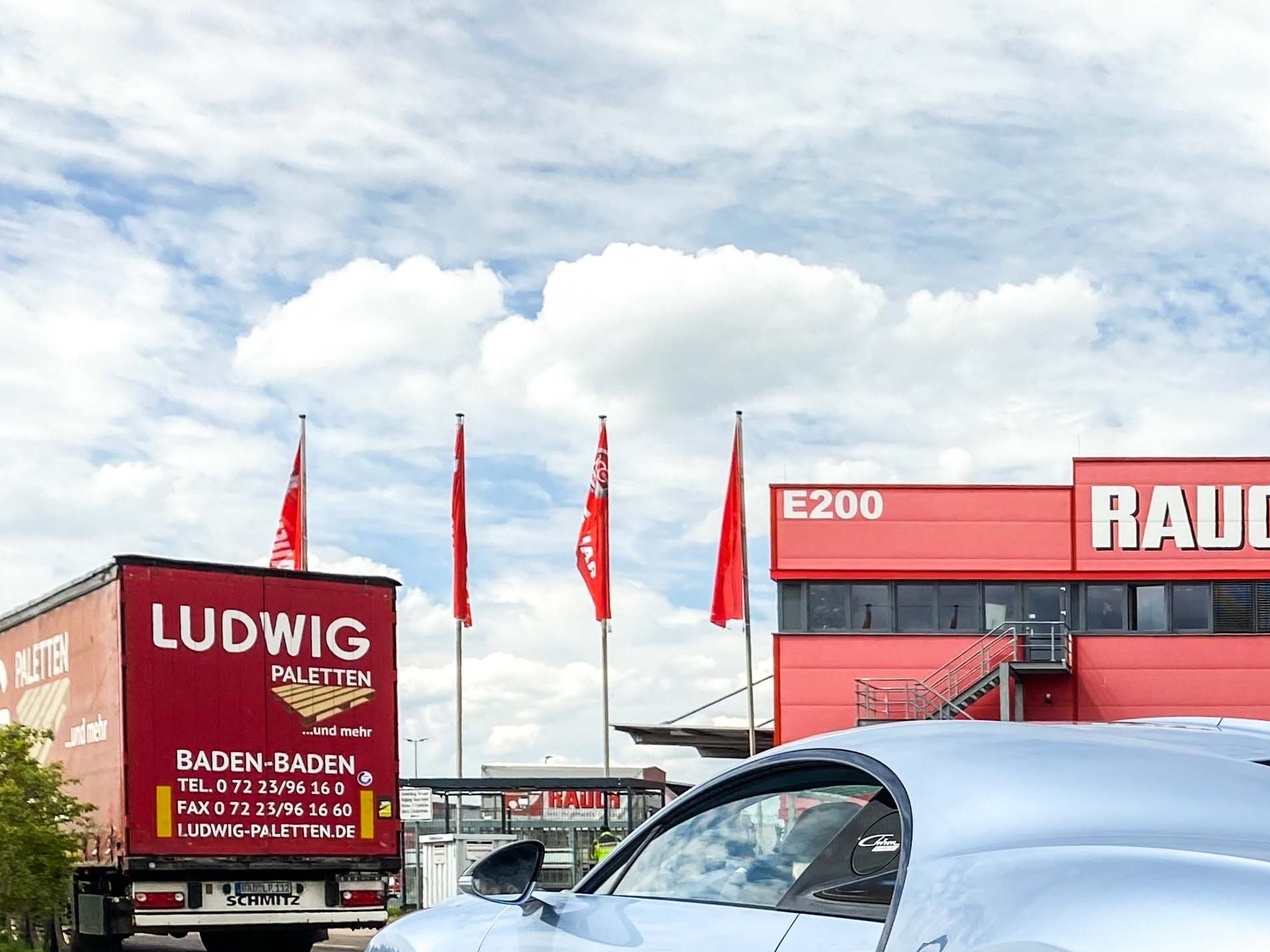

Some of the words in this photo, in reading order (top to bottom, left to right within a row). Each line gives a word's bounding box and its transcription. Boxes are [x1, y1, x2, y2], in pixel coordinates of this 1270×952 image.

[782, 489, 884, 520] E200
[152, 603, 371, 661] LUDWIG
[15, 631, 69, 689] PALETTEN
[271, 664, 372, 687] PALETTEN
[302, 725, 337, 736] ...und
[340, 726, 372, 738] mehr
[176, 749, 355, 775] BADEN-BADEN
[177, 778, 213, 793] TEL.
[216, 779, 227, 793] 0
[232, 780, 252, 794] 72
[258, 780, 306, 796] 23/96
[311, 781, 330, 795] 16
[334, 782, 345, 796] 0
[177, 800, 210, 815] FAX
[214, 801, 225, 815] 0
[229, 802, 250, 816] 72
[255, 802, 304, 817] 23/96
[309, 803, 328, 816] 16
[332, 803, 353, 817] 60
[177, 823, 356, 839] LUDWIG-PALETTEN.DE
[226, 895, 300, 906] SCHMITZ
